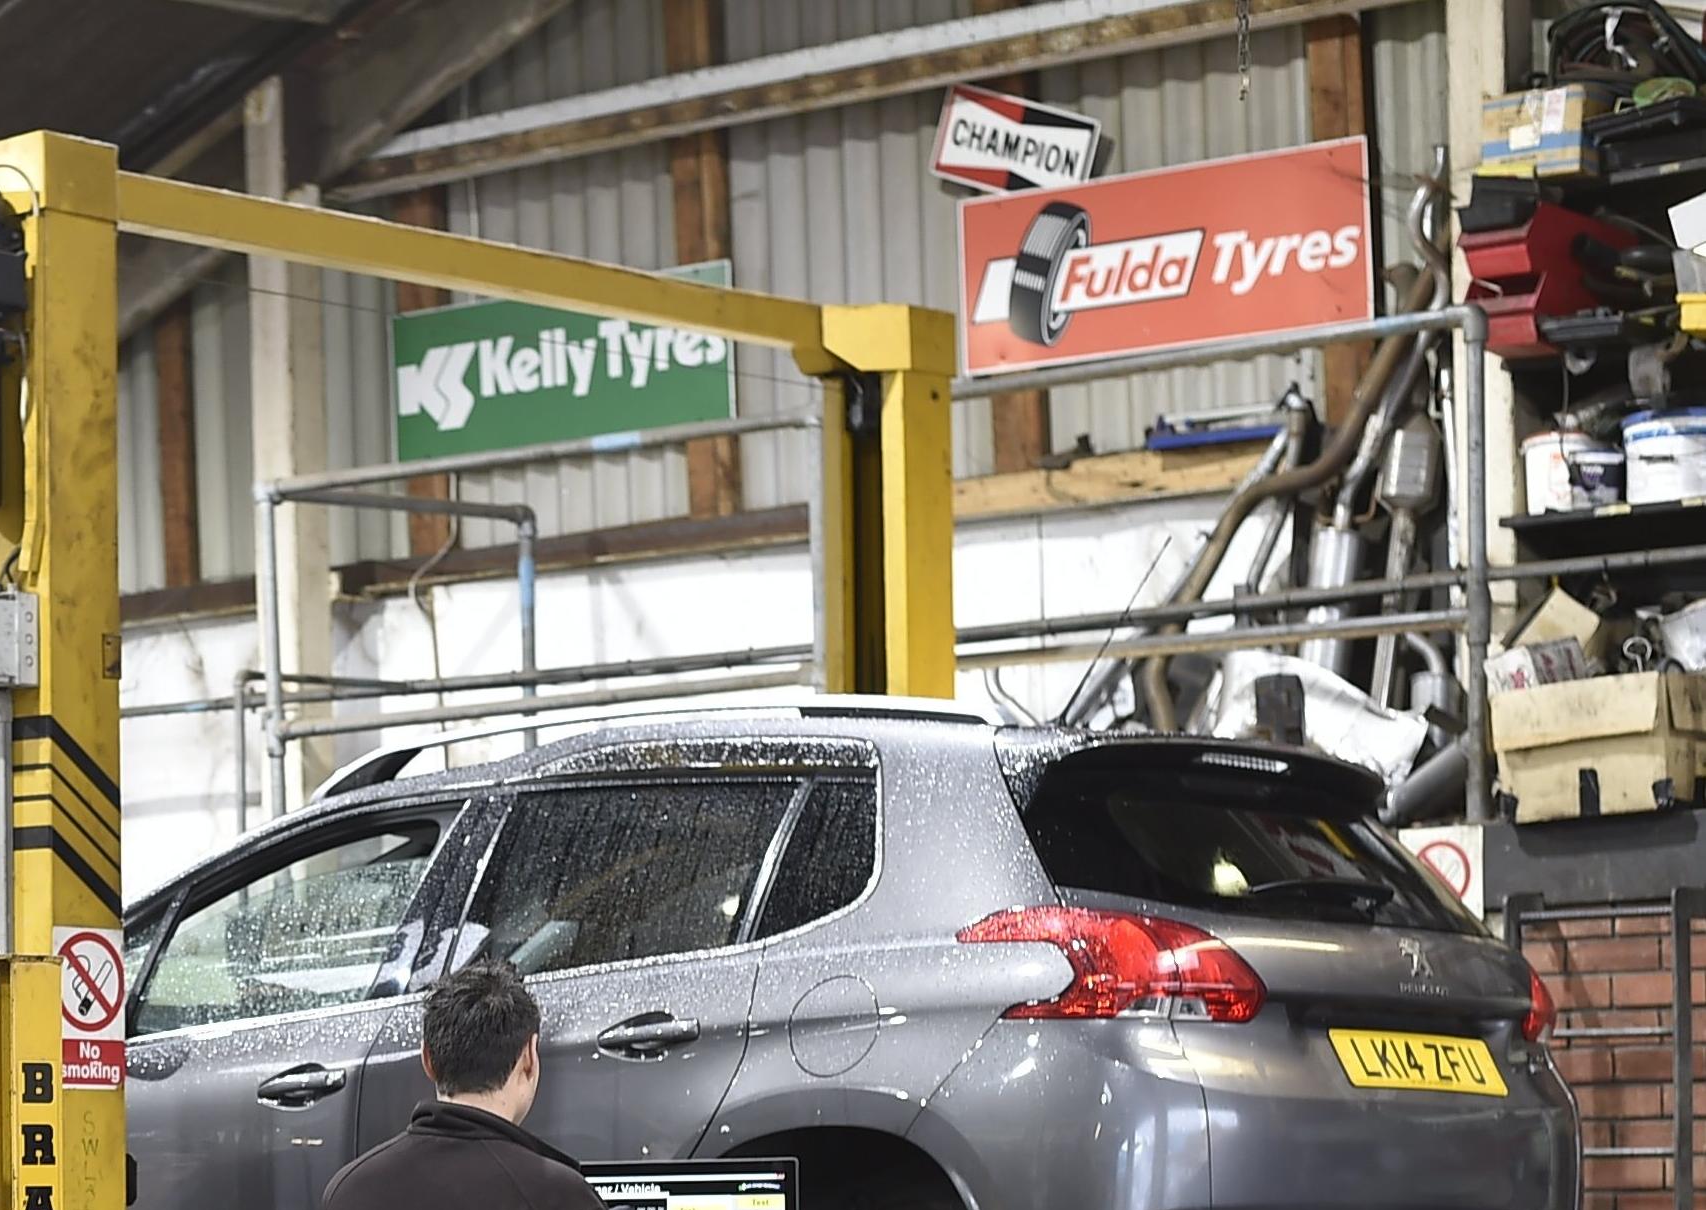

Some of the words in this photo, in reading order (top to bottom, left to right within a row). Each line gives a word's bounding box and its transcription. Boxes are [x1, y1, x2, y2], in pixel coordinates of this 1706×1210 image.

[952, 119, 1080, 178] CHAMPION
[1061, 243, 1192, 303] Fulda
[1211, 224, 1363, 296] Tyres
[477, 327, 598, 398] Kelly
[597, 319, 727, 389] Tyres
[62, 1062, 121, 1083] smoking
[79, 1041, 101, 1060] No
[1350, 1037, 1426, 1080] LK14
[1423, 1042, 1487, 1086] ZFU
